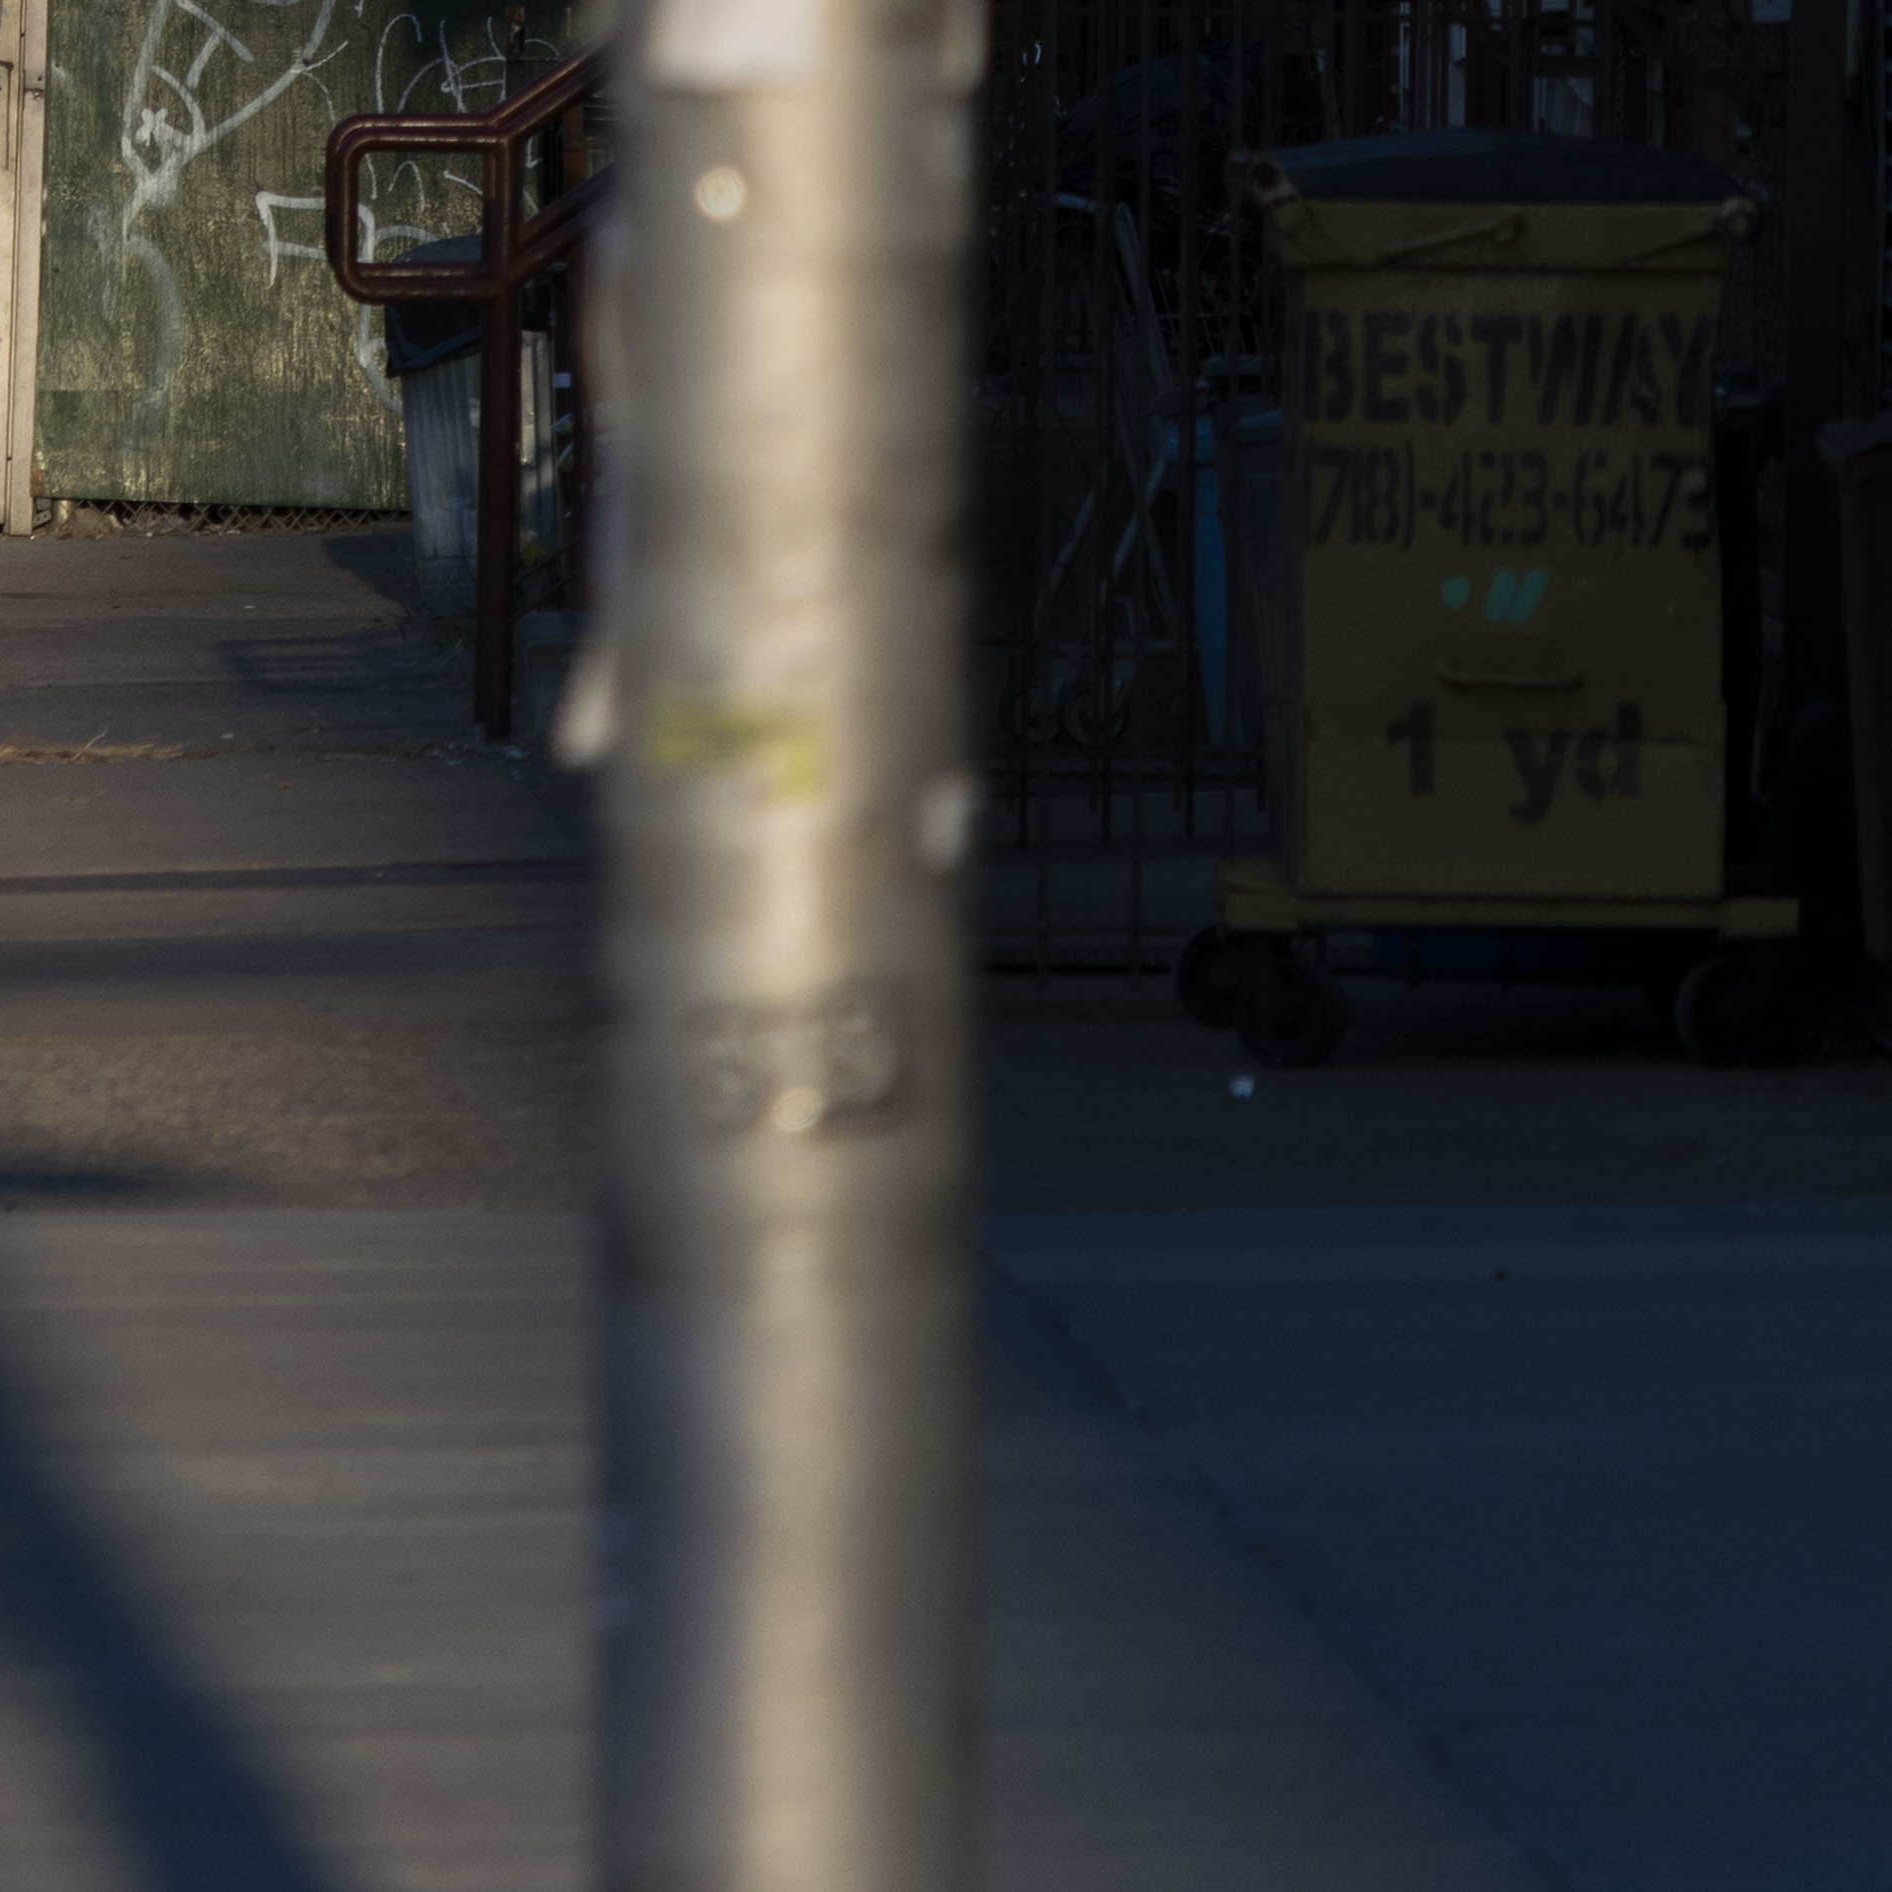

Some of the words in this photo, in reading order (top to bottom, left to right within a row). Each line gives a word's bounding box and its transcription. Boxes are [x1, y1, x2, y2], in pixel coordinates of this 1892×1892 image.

[1306, 308, 1715, 427] BESTWAY
[1388, 700, 1436, 796] 1
[1506, 702, 1642, 824] yd
